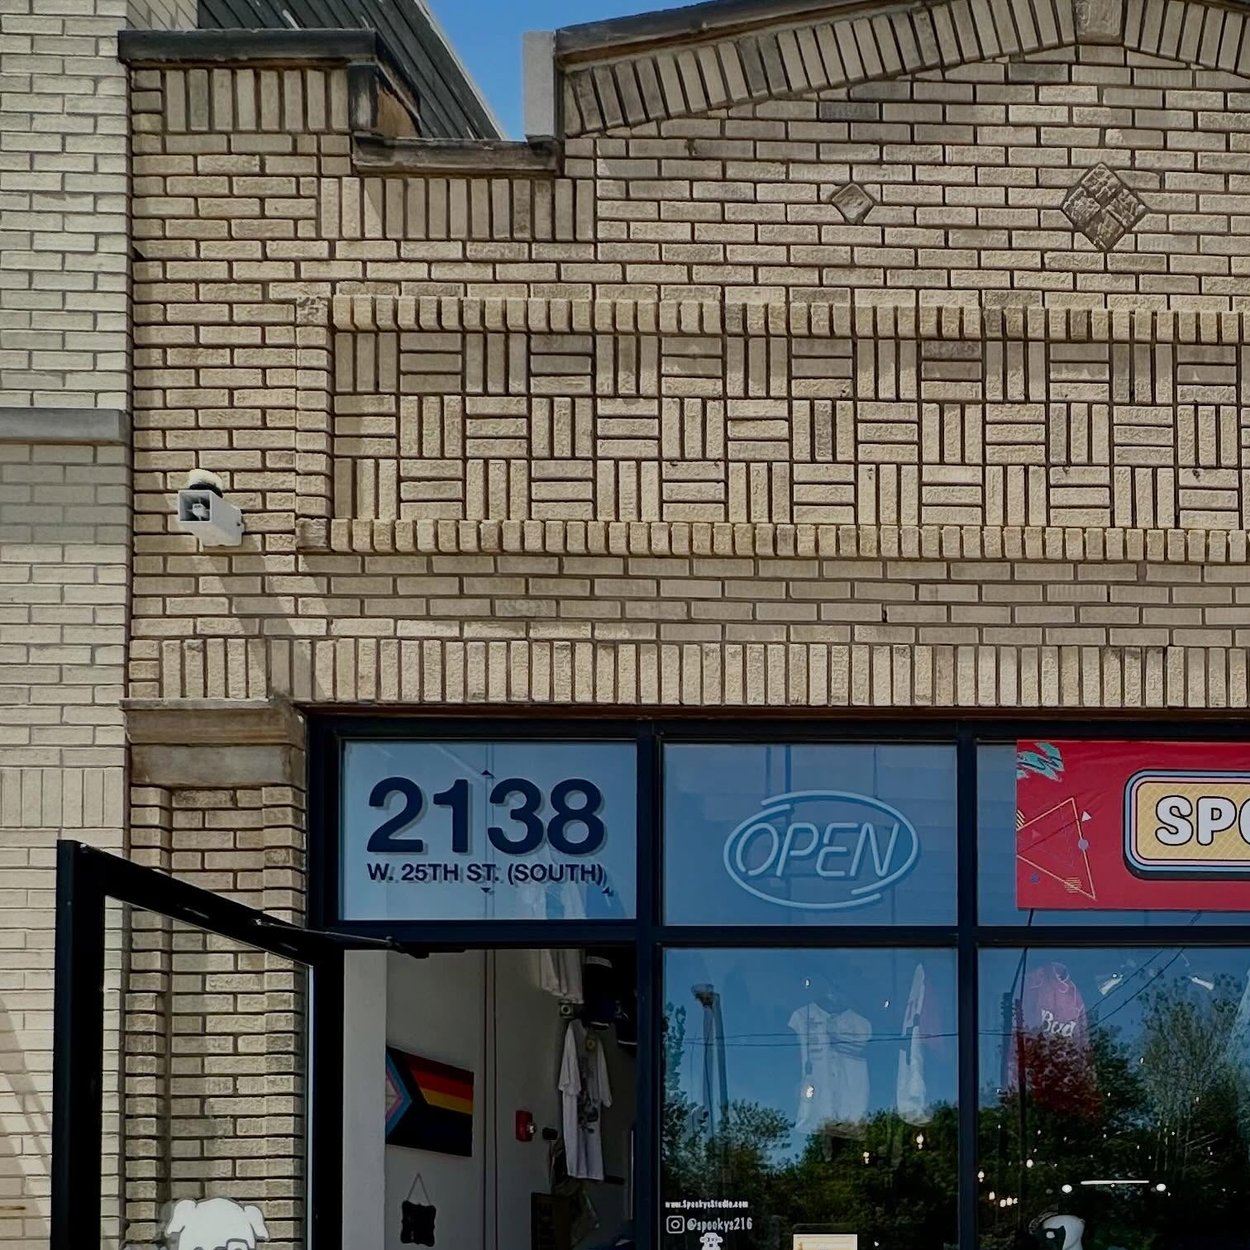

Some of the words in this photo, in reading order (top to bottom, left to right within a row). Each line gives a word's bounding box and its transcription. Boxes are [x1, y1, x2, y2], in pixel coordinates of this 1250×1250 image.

[366, 776, 602, 855] 2138
[736, 820, 900, 878] OPEN
[366, 863, 394, 883] W.
[401, 863, 460, 883] 25TH
[507, 861, 604, 886] (SOUTH)
[686, 1217, 753, 1233] @spookys216
